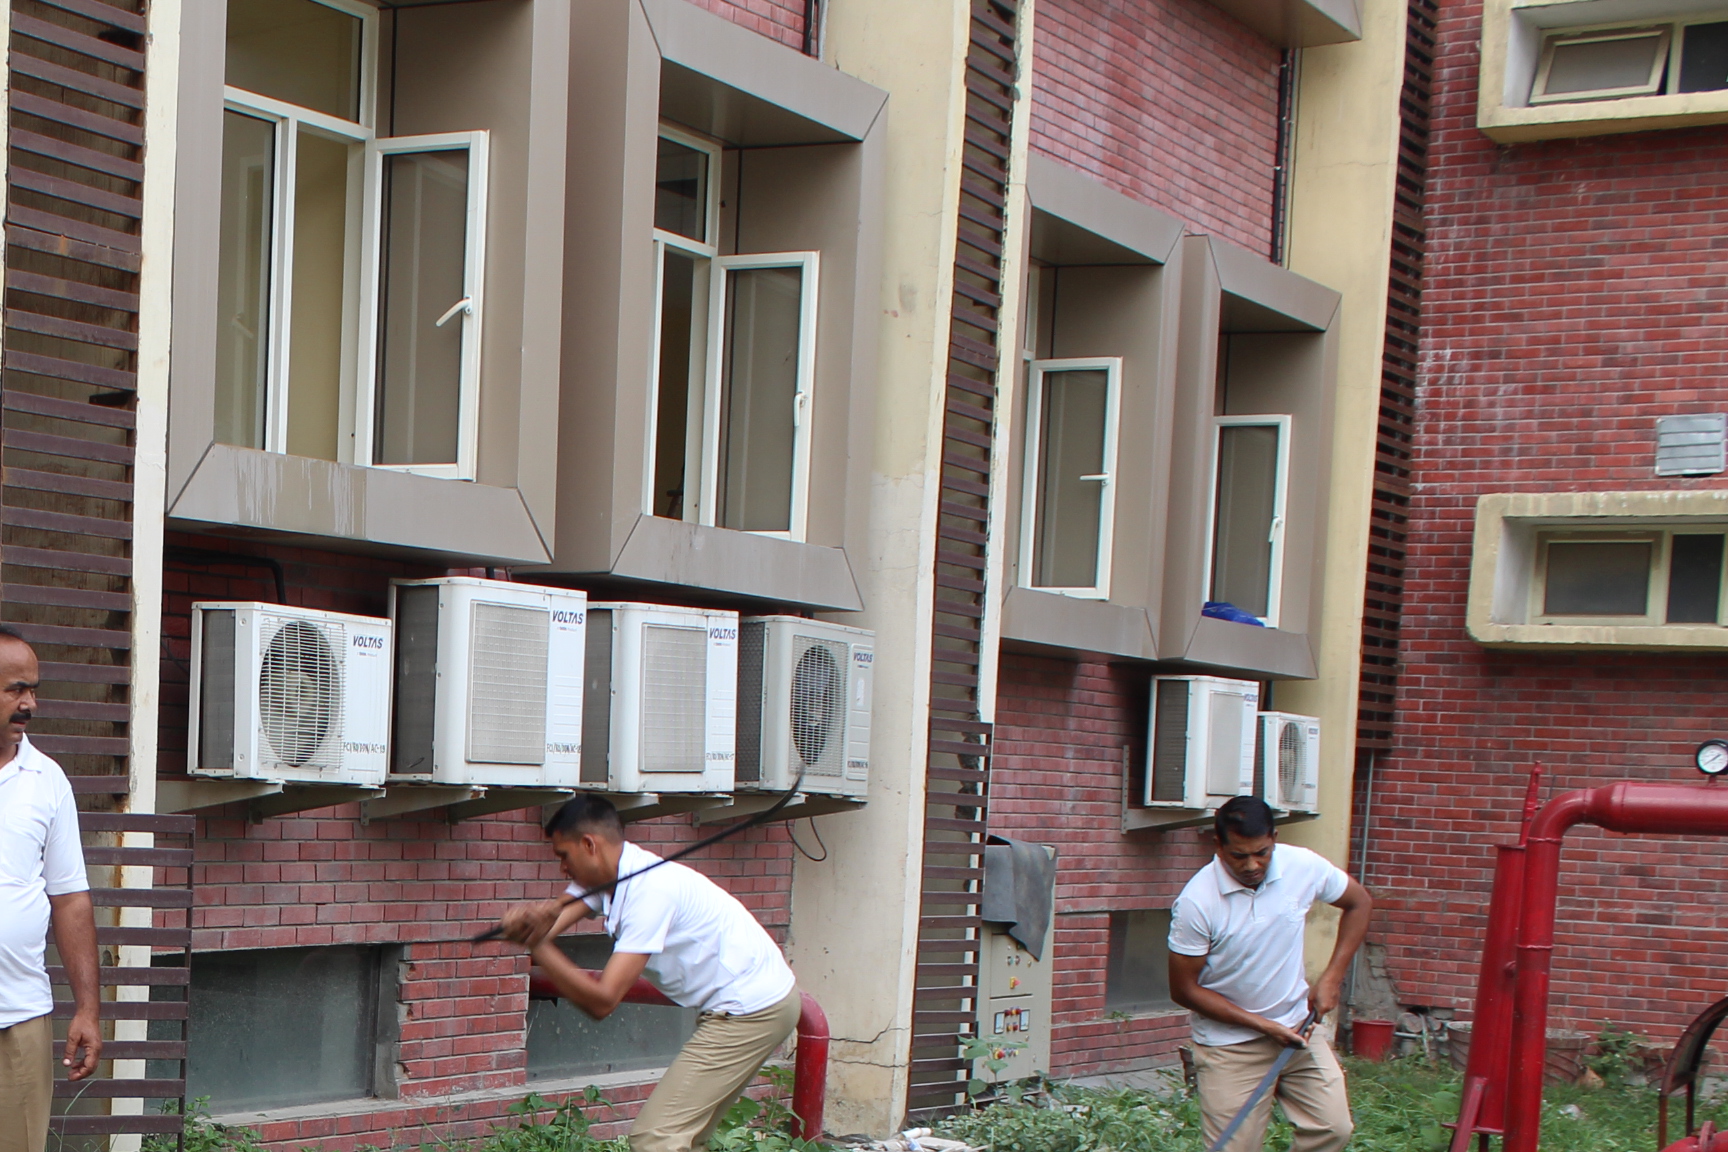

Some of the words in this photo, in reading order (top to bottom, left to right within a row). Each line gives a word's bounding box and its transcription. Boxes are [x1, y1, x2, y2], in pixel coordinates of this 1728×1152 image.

[552, 610, 584, 625] VOLTAS
[709, 628, 737, 640] VOLTAS
[353, 635, 384, 649] VOLTAS
